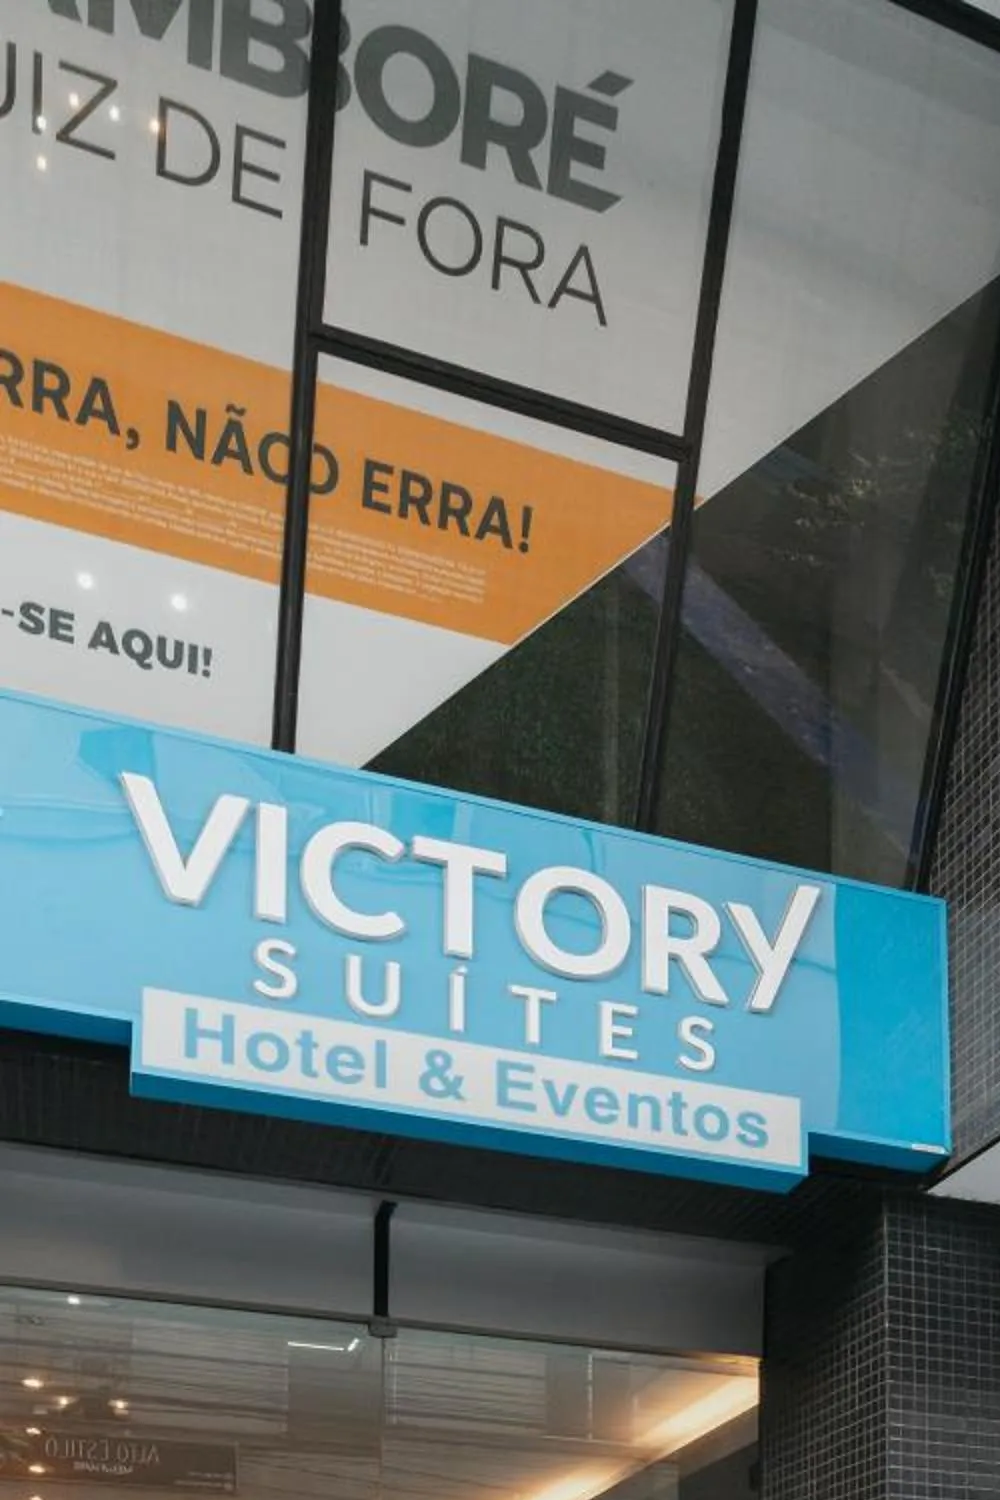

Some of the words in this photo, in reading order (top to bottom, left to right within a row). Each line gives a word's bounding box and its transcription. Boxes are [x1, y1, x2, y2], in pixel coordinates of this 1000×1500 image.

[48, 0, 634, 213] MBORÉ
[156, 96, 287, 220] DE
[359, 169, 608, 327] FORA
[165, 399, 339, 495] NÃO
[361, 459, 533, 552] ERRA!
[87, 620, 212, 678] AQUI!
[120, 770, 822, 1014] VICTORY
[184, 1008, 388, 1089] Hotel
[418, 1049, 466, 1100] &
[495, 1058, 770, 1149] Eventos
[253, 938, 716, 1072] SUÍTES
